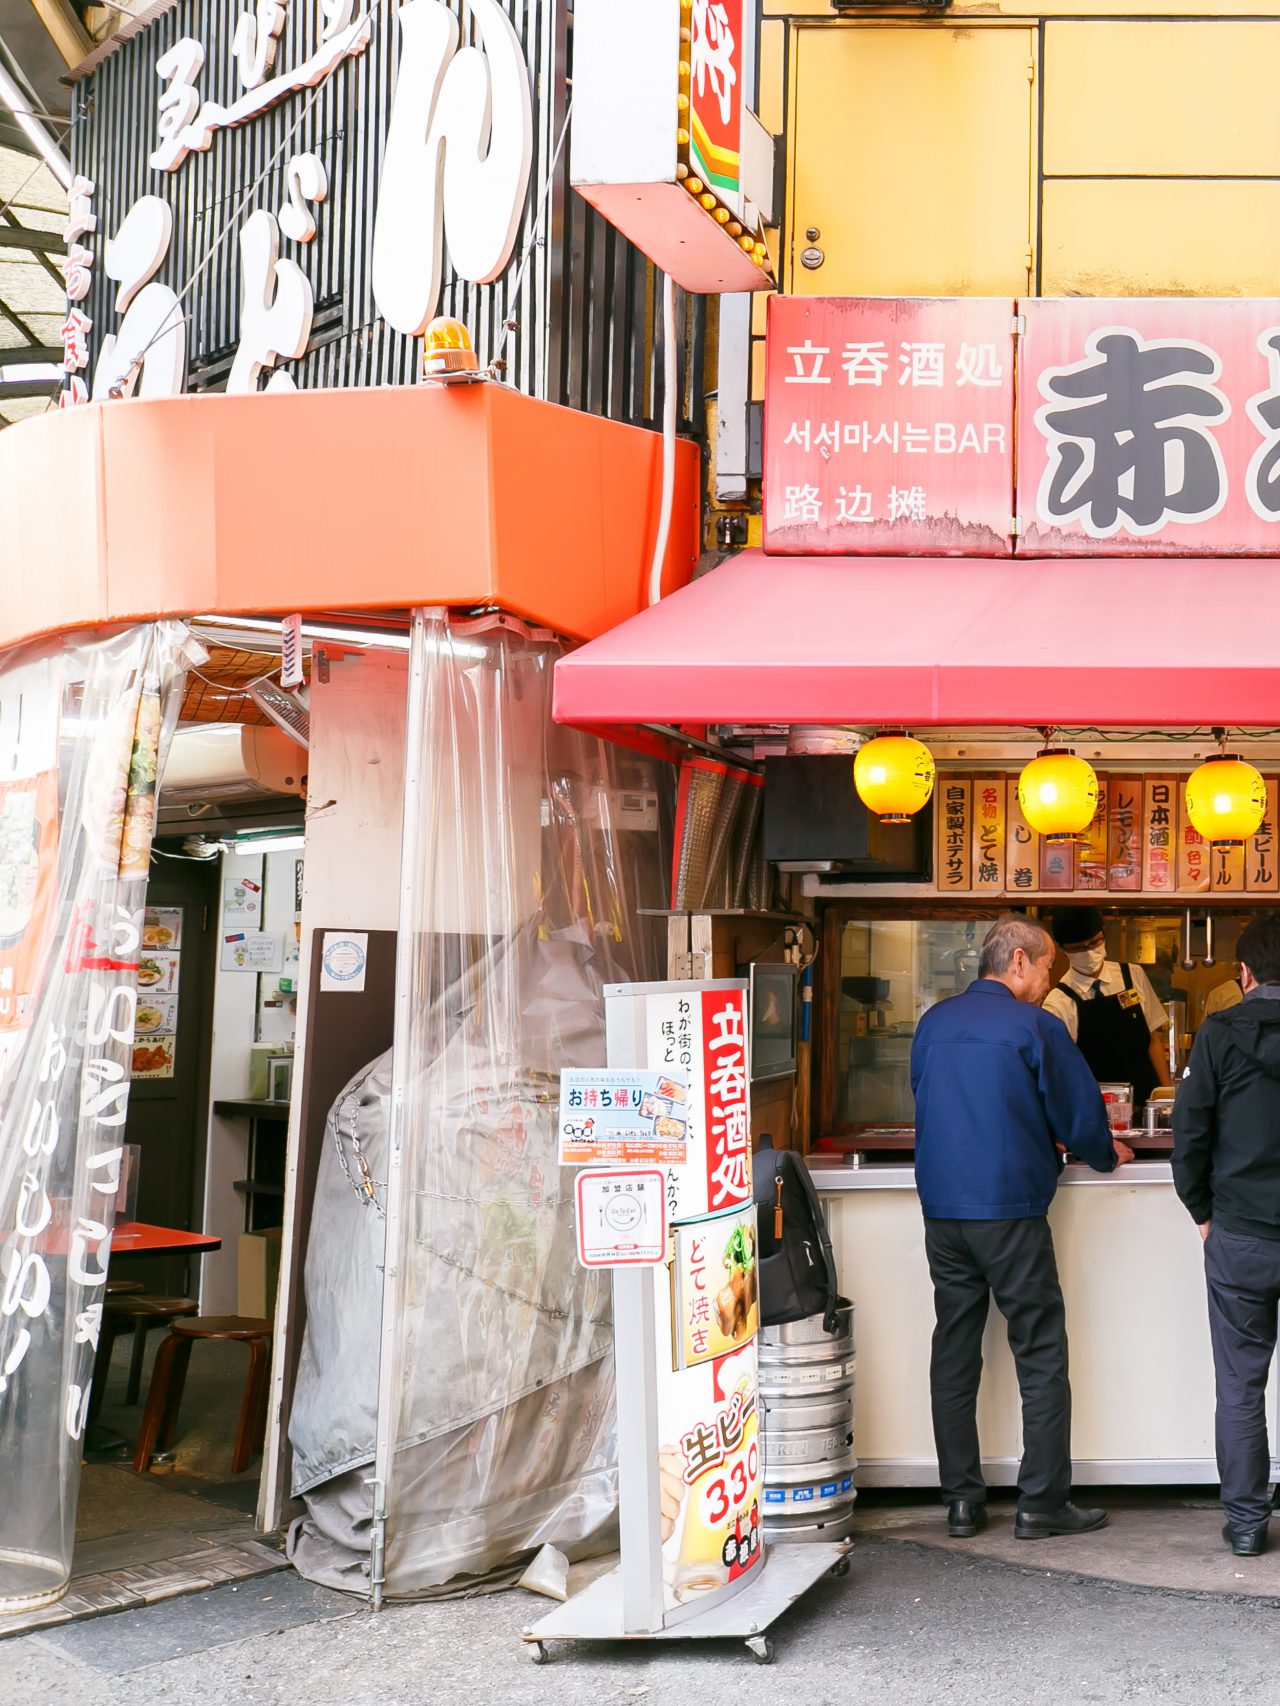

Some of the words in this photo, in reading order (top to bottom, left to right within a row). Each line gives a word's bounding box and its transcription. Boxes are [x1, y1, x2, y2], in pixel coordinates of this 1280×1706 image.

[784, 339, 1004, 388] 立呑酒処
[783, 419, 1006, 455] 서서마시는BAR
[783, 484, 927, 525] 路边摊
[946, 786, 965, 885] 自家製ポテサラ
[982, 787, 998, 820] 名物
[1014, 786, 1033, 888] し巻
[568, 1088, 643, 1108] お持ち帰り
[708, 1003, 750, 1206] 立呑酒処
[688, 1237, 710, 1355] どて焼き
[705, 1442, 758, 1524] 330
